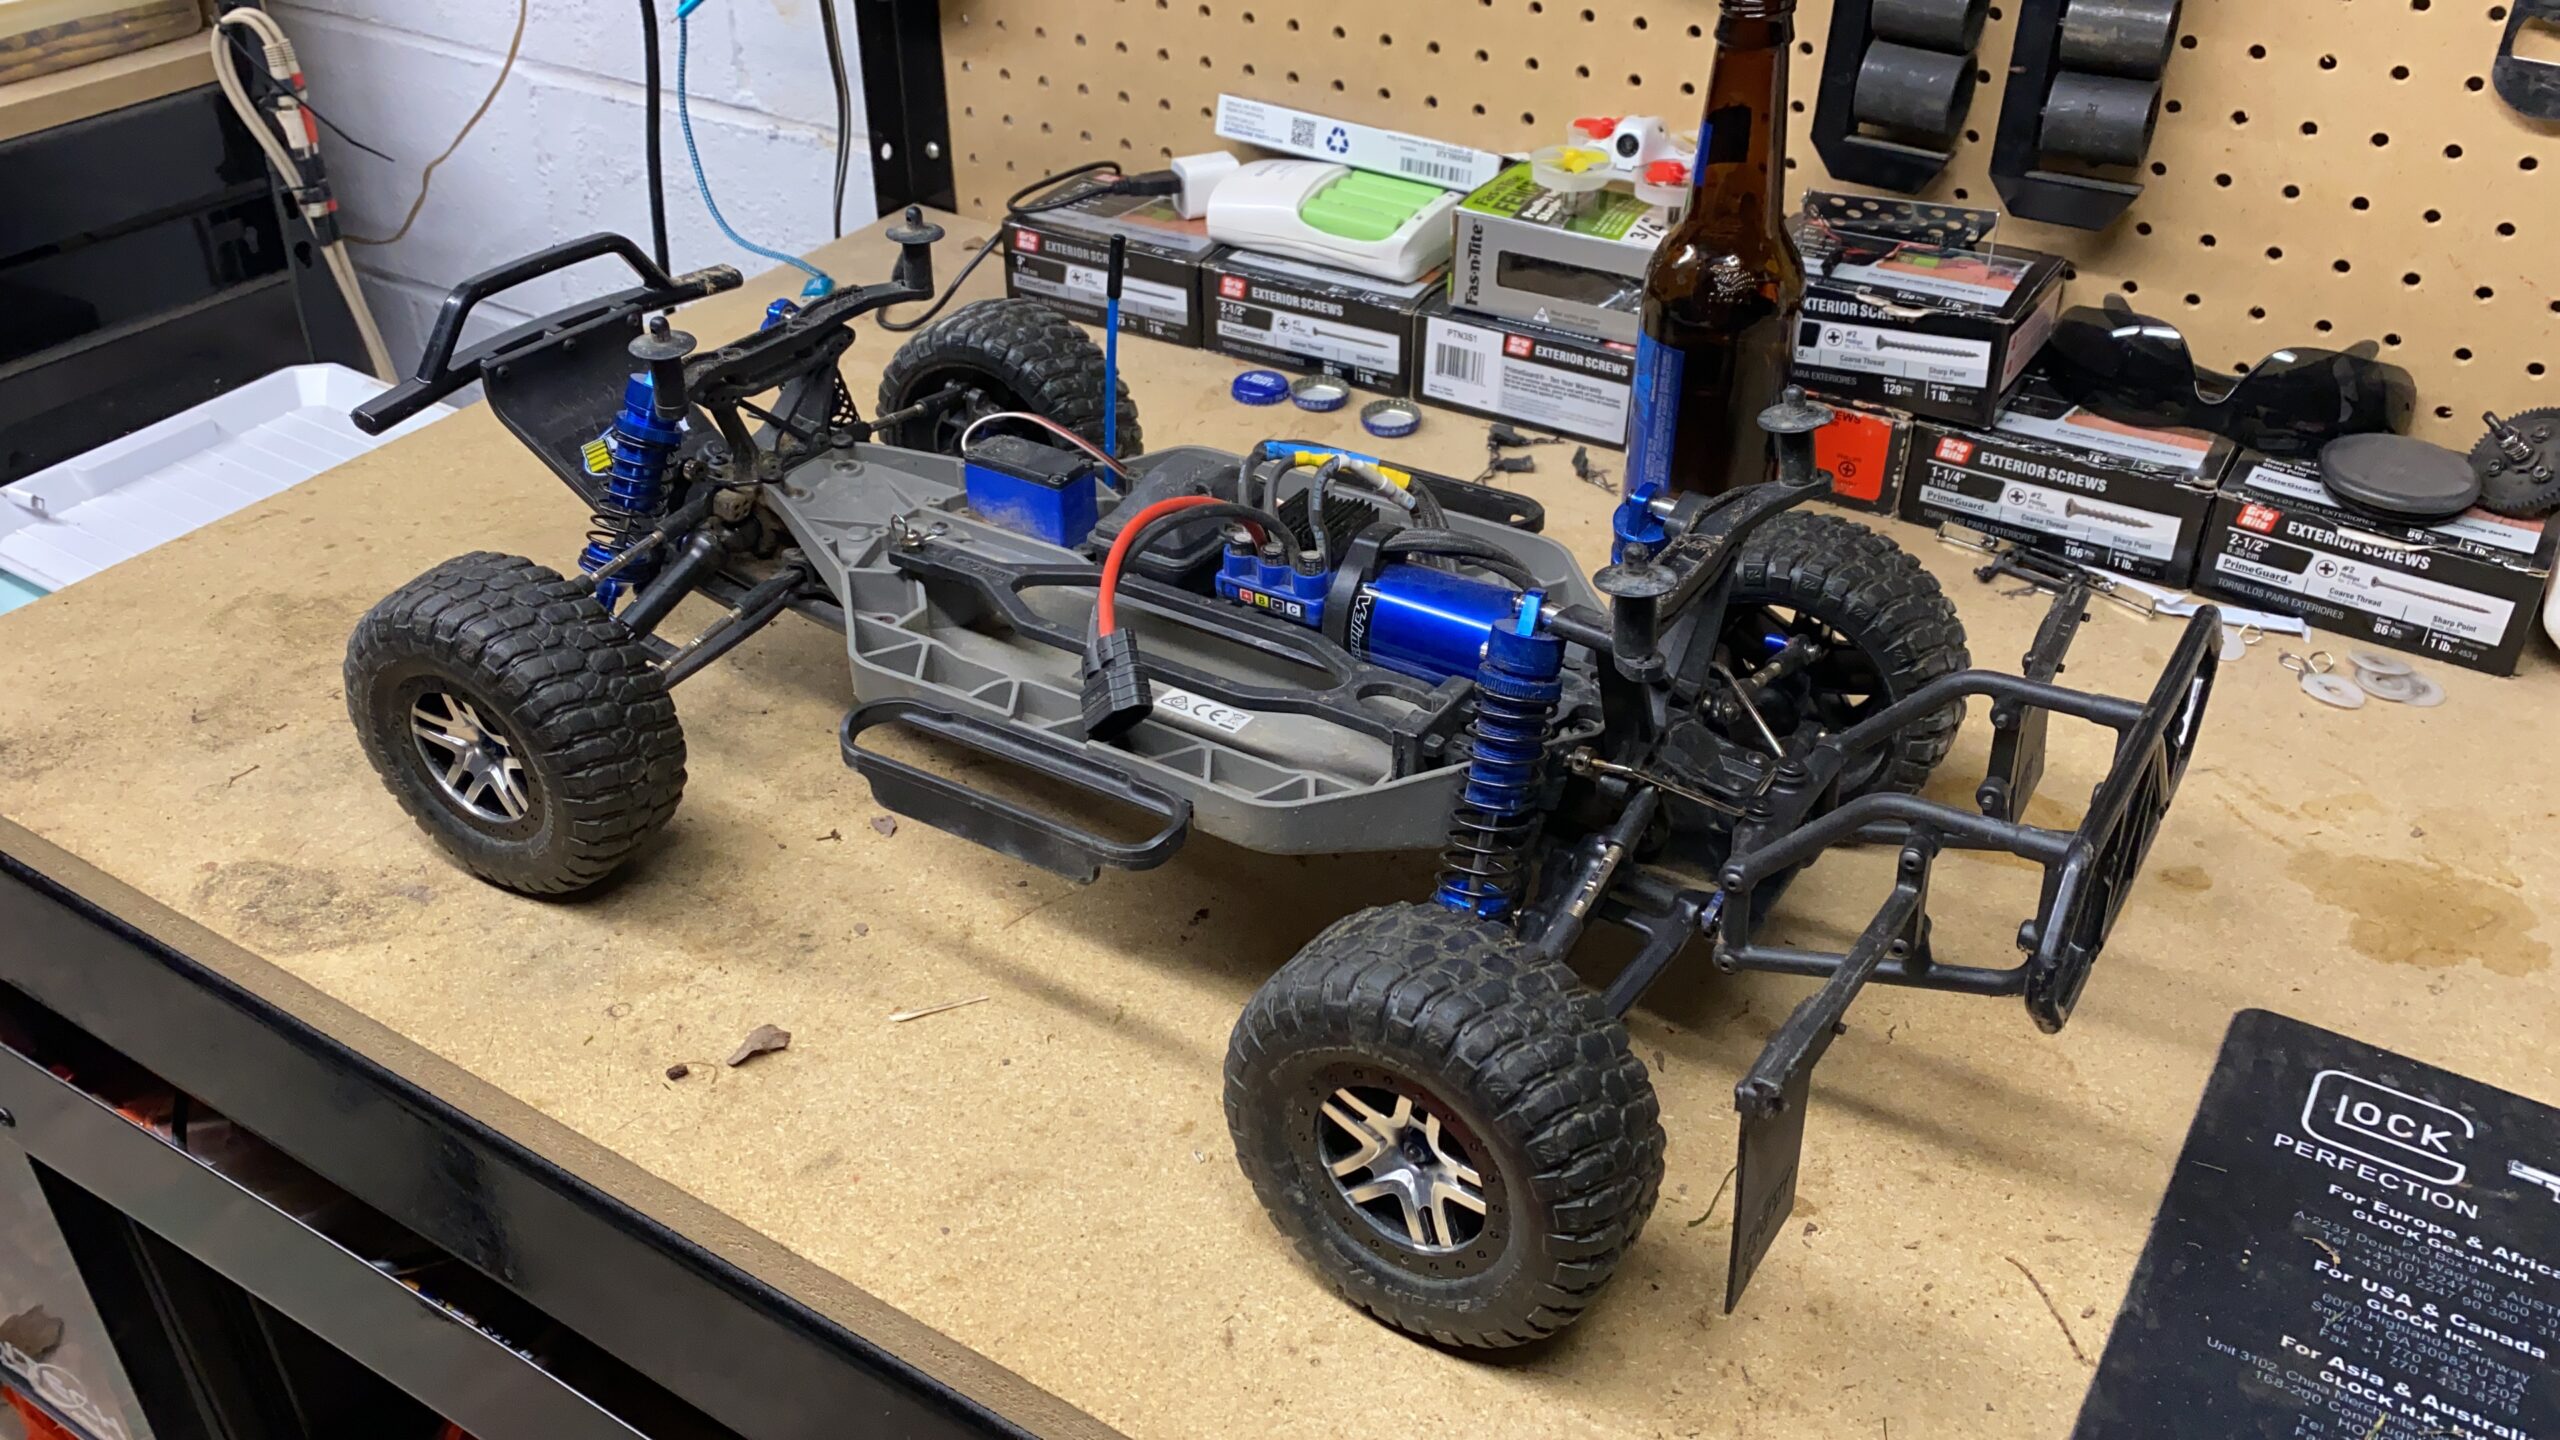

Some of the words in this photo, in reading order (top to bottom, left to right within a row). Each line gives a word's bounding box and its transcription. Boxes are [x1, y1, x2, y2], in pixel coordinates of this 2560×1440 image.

[1045, 240, 1090, 262] EXTERIOR
[1091, 250, 1129, 269] SCRS
[1220, 302, 1247, 317] 2-1/2"
[1252, 287, 1300, 308] EXTERIOR
[1300, 297, 1344, 317] SCREWS
[1804, 296, 1858, 317] XTERIOR
[1535, 345, 1584, 366] EXTERIOR
[1585, 357, 1628, 377] SCREWS
[1883, 383, 1902, 396] 129
[1939, 448, 1965, 462] Rite
[1943, 438, 1968, 453] Grip
[1931, 466, 1966, 483] 1-1/4"
[1980, 452, 2046, 478] EXTERIOR
[2048, 466, 2107, 493] SCREWS
[2255, 473, 2322, 495] PrimeGuard
[1927, 490, 1984, 512] PrimeGuard
[2246, 505, 2274, 521] Grip
[1967, 519, 1989, 532] PARA
[1989, 526, 2038, 545] EXTERIORES
[2021, 513, 2044, 525] Coarse
[2045, 519, 2068, 530] Thread
[2241, 517, 2270, 531] Rite
[2064, 545, 2083, 558] 196
[2113, 535, 2132, 547] Sharp
[2133, 541, 2153, 550] Point
[2226, 546, 2245, 558] 6.35
[2246, 552, 2260, 561] cm
[2229, 533, 2270, 553] 2-1/2"
[2286, 520, 2360, 553] EXTERIOR
[2363, 541, 2431, 571] SCREWS
[2223, 558, 2289, 583] PrimeGuard
[2341, 565, 2356, 574] #2
[1258, 595, 1266, 605] B
[1289, 605, 1297, 614] C
[2218, 577, 2264, 598] TORNILLOS
[2266, 592, 2289, 606] PARA
[2290, 598, 2345, 620] EXTERIORES
[2329, 587, 2355, 599] Coarse
[2356, 594, 2382, 607] Thread
[2373, 623, 2389, 636] 86
[2433, 615, 2456, 628] Sharp
[2456, 621, 2478, 633] Point
[2430, 638, 2437, 648] 1
[2438, 640, 2453, 654] lb.
[1193, 703, 1228, 722] CE
[2273, 1132, 2479, 1220] PERFECTION
[2328, 1183, 2367, 1205] For
[2373, 1200, 2457, 1240] Europe
[2465, 1236, 2484, 1250] &
[2352, 1209, 2421, 1242] GLOCK
[2427, 1238, 2535, 1285] Ges.m.b.H.
[2294, 1210, 2351, 1236] A-2232
[2507, 1291, 2560, 1318] AUST
[2435, 1252, 2463, 1268] Box
[2355, 1255, 2382, 1271] +43
[2387, 1268, 2409, 1284] (0)
[2415, 1278, 2456, 1299] 2247
[2462, 1295, 2482, 1310] 90
[2488, 1306, 2519, 1324] 300
[2364, 1248, 2392, 1264] +43
[2398, 1261, 2421, 1276] (0)
[2426, 1271, 2467, 1292] 2247
[2473, 1288, 2493, 1303] 90
[2499, 1299, 2530, 1317] 300
[2314, 1259, 2354, 1282] For
[2361, 1278, 2413, 1308] USA
[2422, 1303, 2440, 1318] &
[2449, 1313, 2546, 1359] Canada
[2366, 1298, 2438, 1333] GLOCK
[2445, 1329, 2483, 1352] Inc.
[2322, 1293, 2362, 1315] 6000
[2368, 1311, 2451, 1351] Highlands
[2458, 1346, 2530, 1384] Parkway
[2385, 1331, 2411, 1348] GA
[2417, 1342, 2469, 1370] 30082
[2206, 1335, 2236, 1356] Unit
[2286, 1370, 2330, 1396] China
[2392, 1345, 2422, 1363] 770
[2440, 1365, 2472, 1382] 432
[2480, 1381, 2521, 1403] 1202
[2255, 1370, 2322, 1405] 168-200
[2280, 1334, 2322, 1360] For
[2328, 1356, 2384, 1387] Asia
[2393, 1382, 2412, 1398] &
[2421, 1394, 2537, 1440] Australi
[2320, 1370, 2394, 1409] GLOCK
[2400, 1403, 2445, 1429] H.K.
[2437, 1377, 2469, 1396] 433
[2475, 1391, 2518, 1415] 8719
